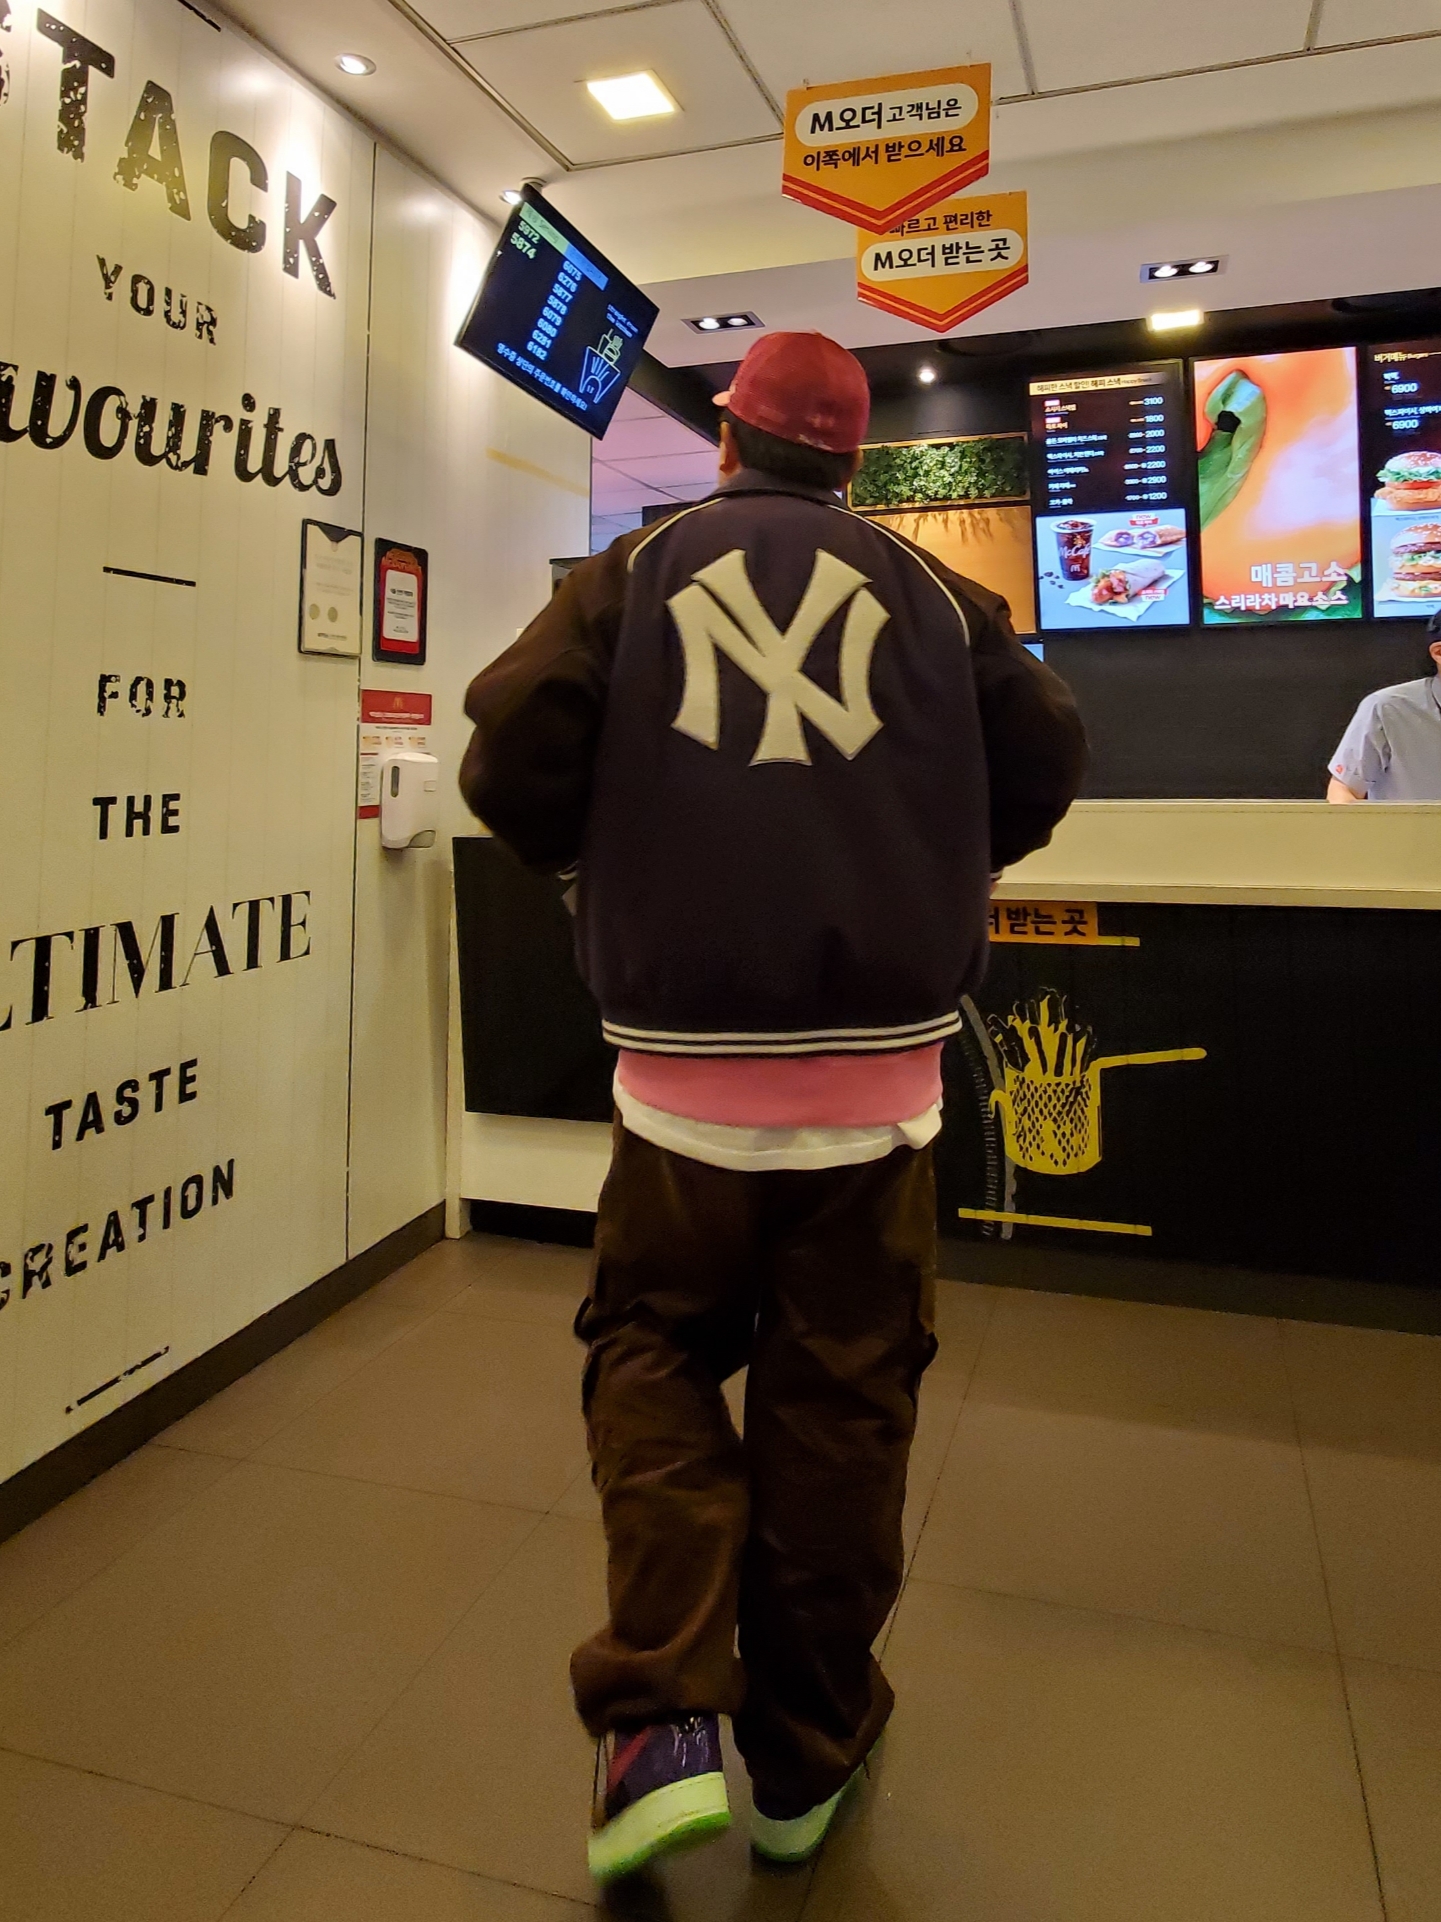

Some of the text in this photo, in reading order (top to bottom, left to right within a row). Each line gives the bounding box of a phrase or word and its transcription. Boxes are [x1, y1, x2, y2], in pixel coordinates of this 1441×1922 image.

[810, 98, 962, 134] M오더 고객님은
[0, 0, 337, 300] TACK
[803, 135, 967, 171] 이쪽에서 받으세요
[943, 210, 993, 231] 편리한
[873, 244, 935, 271] M오더
[96, 254, 218, 346] YOUR
[1250, 561, 1348, 588] 매콤고소
[665, 548, 891, 767] NY
[97, 673, 188, 719] FOR
[92, 792, 181, 840] THE
[44, 1057, 198, 1151] TASTE
